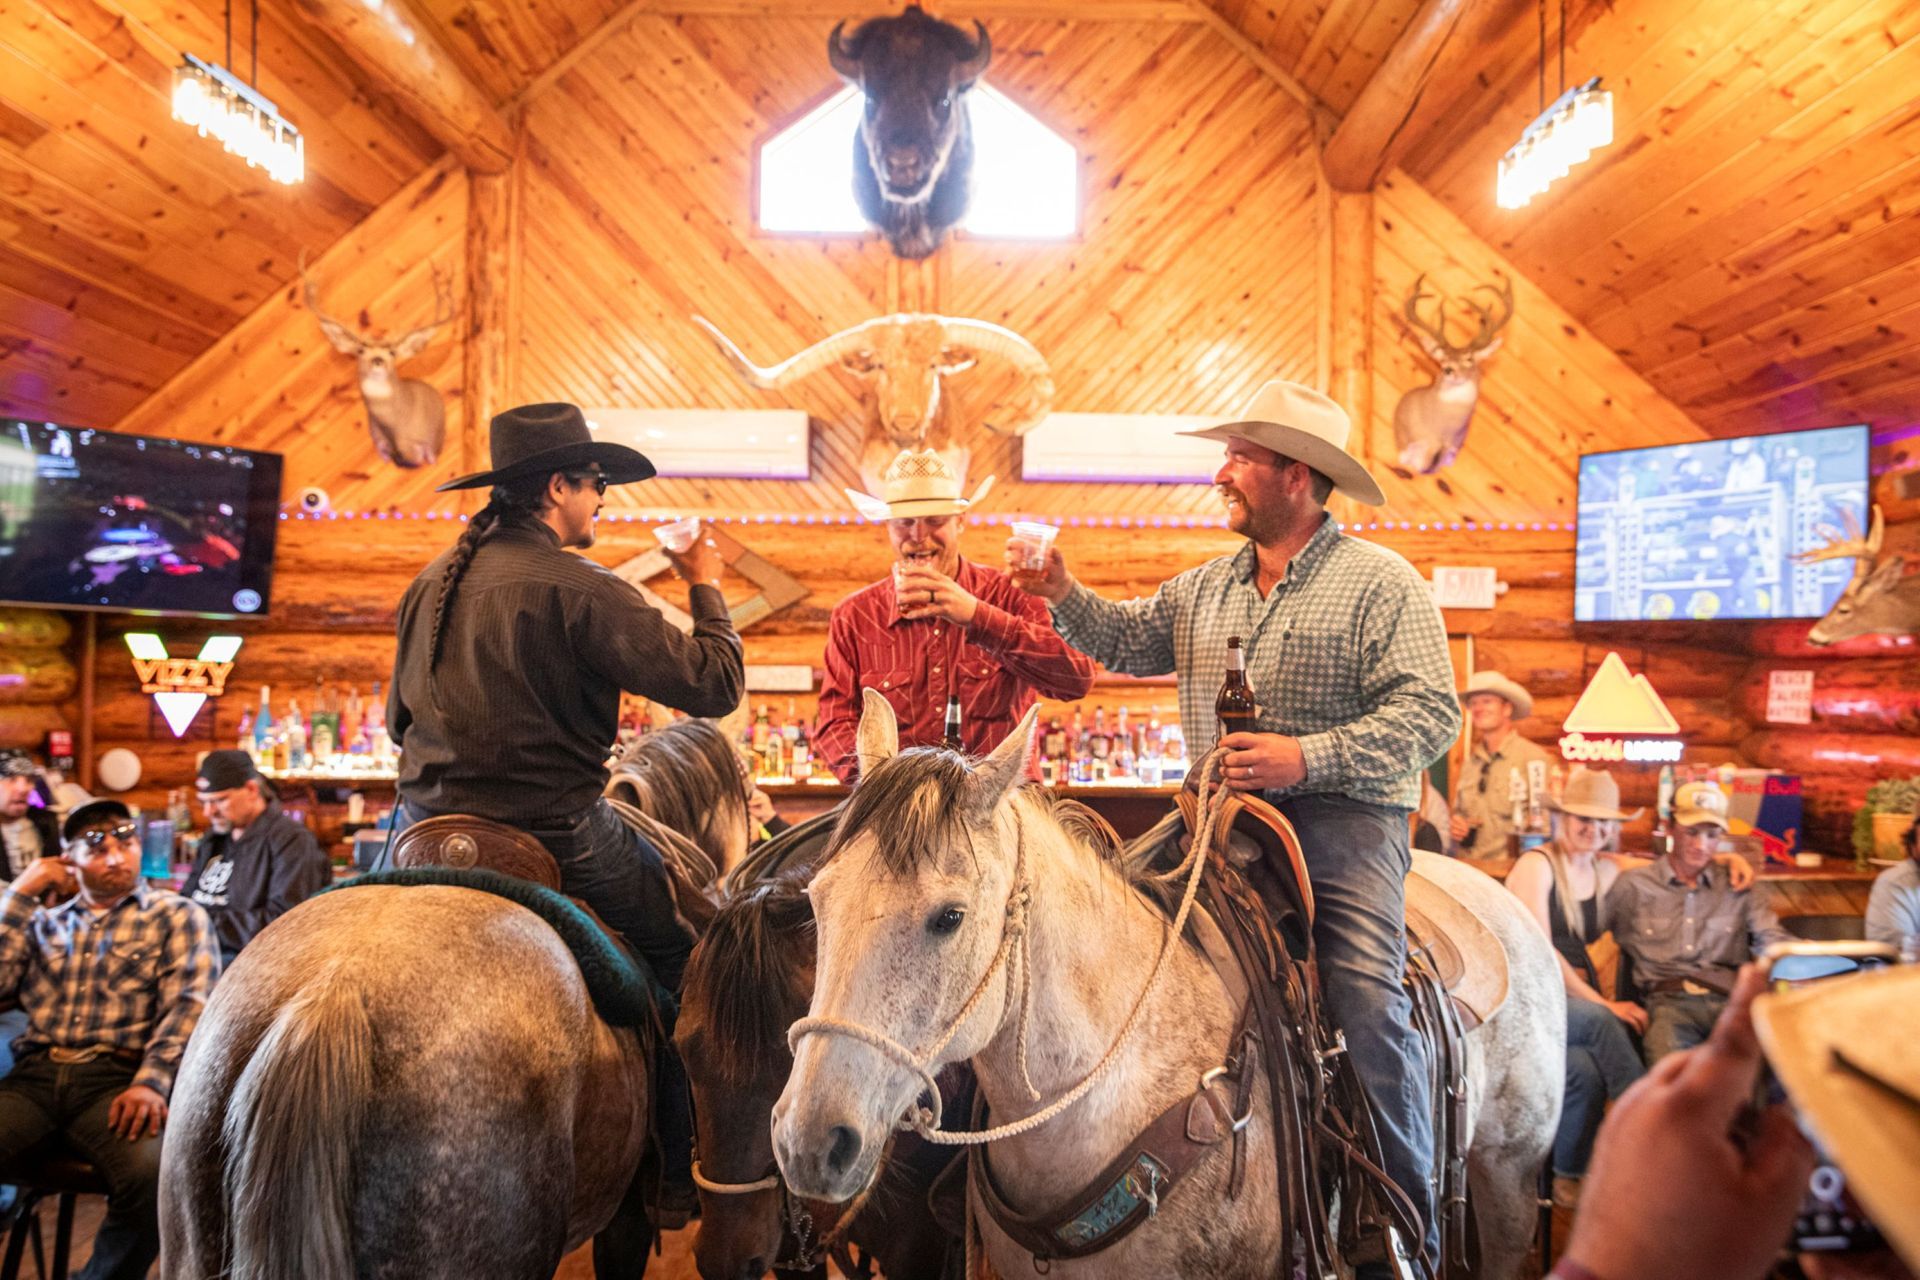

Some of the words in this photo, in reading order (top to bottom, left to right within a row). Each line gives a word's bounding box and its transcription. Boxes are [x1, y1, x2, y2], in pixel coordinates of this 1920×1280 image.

[131, 658, 234, 687] VIZZY
[1733, 775, 1764, 794] Red
[1766, 776, 1800, 795] Bull
